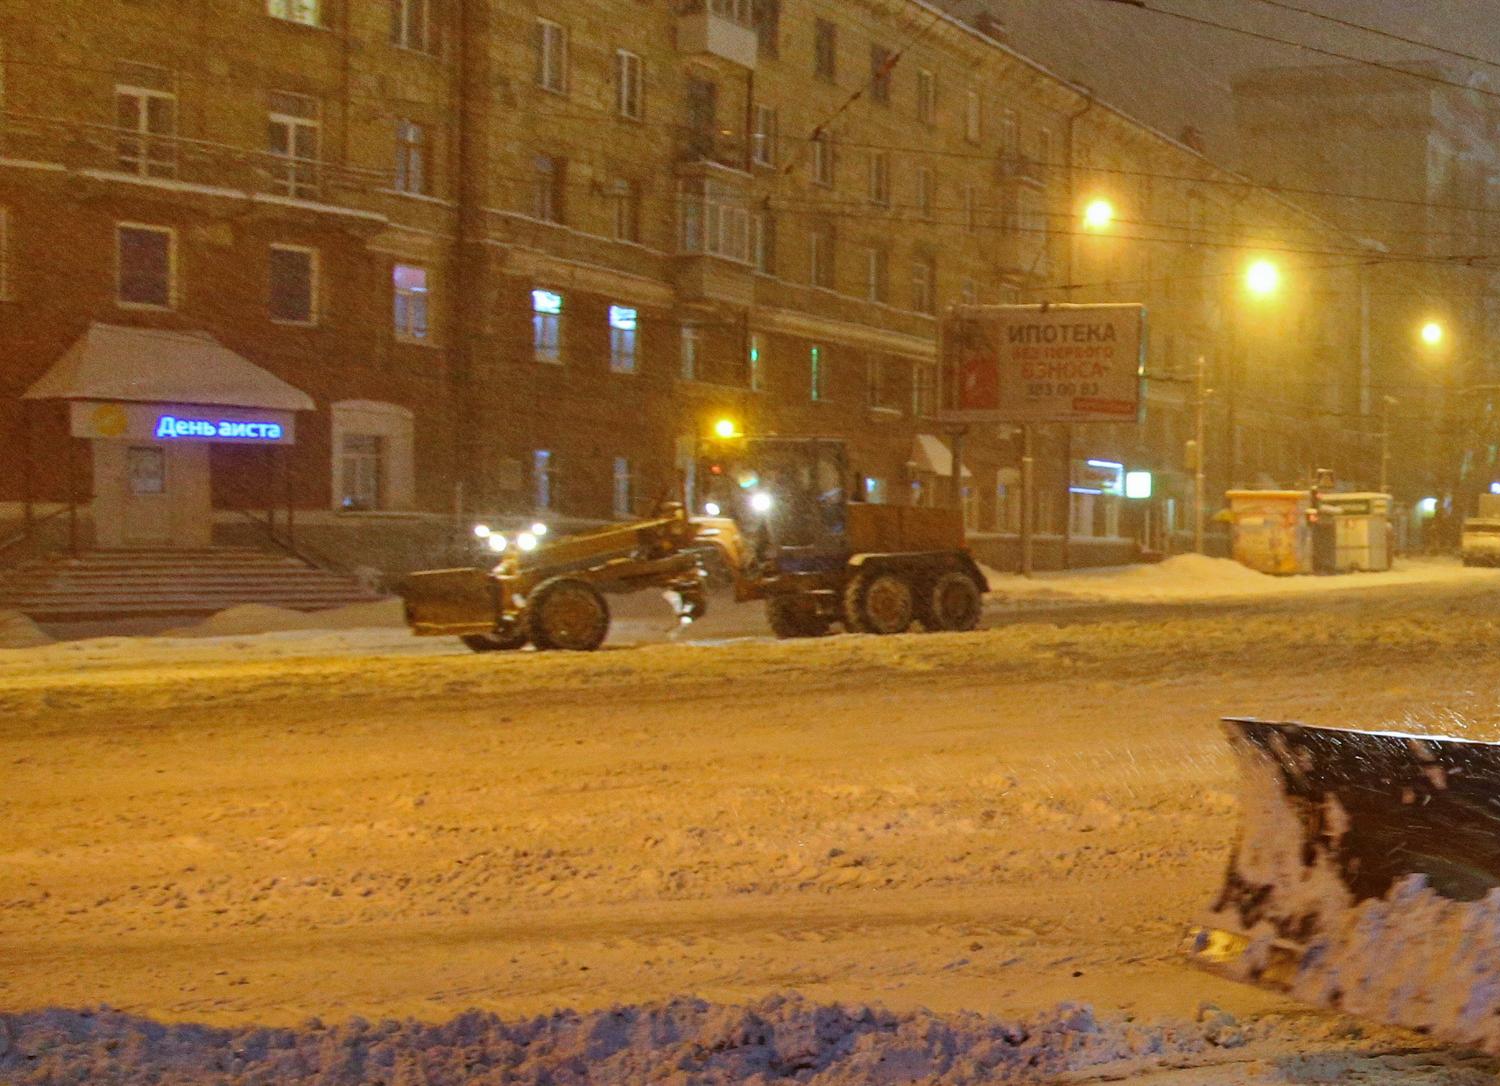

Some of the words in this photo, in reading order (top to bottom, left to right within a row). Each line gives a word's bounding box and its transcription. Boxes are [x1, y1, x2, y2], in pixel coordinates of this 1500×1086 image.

[1008, 323, 1115, 342] ИПОТЕКА
[157, 416, 217, 438] День
[218, 421, 282, 439] аиста
